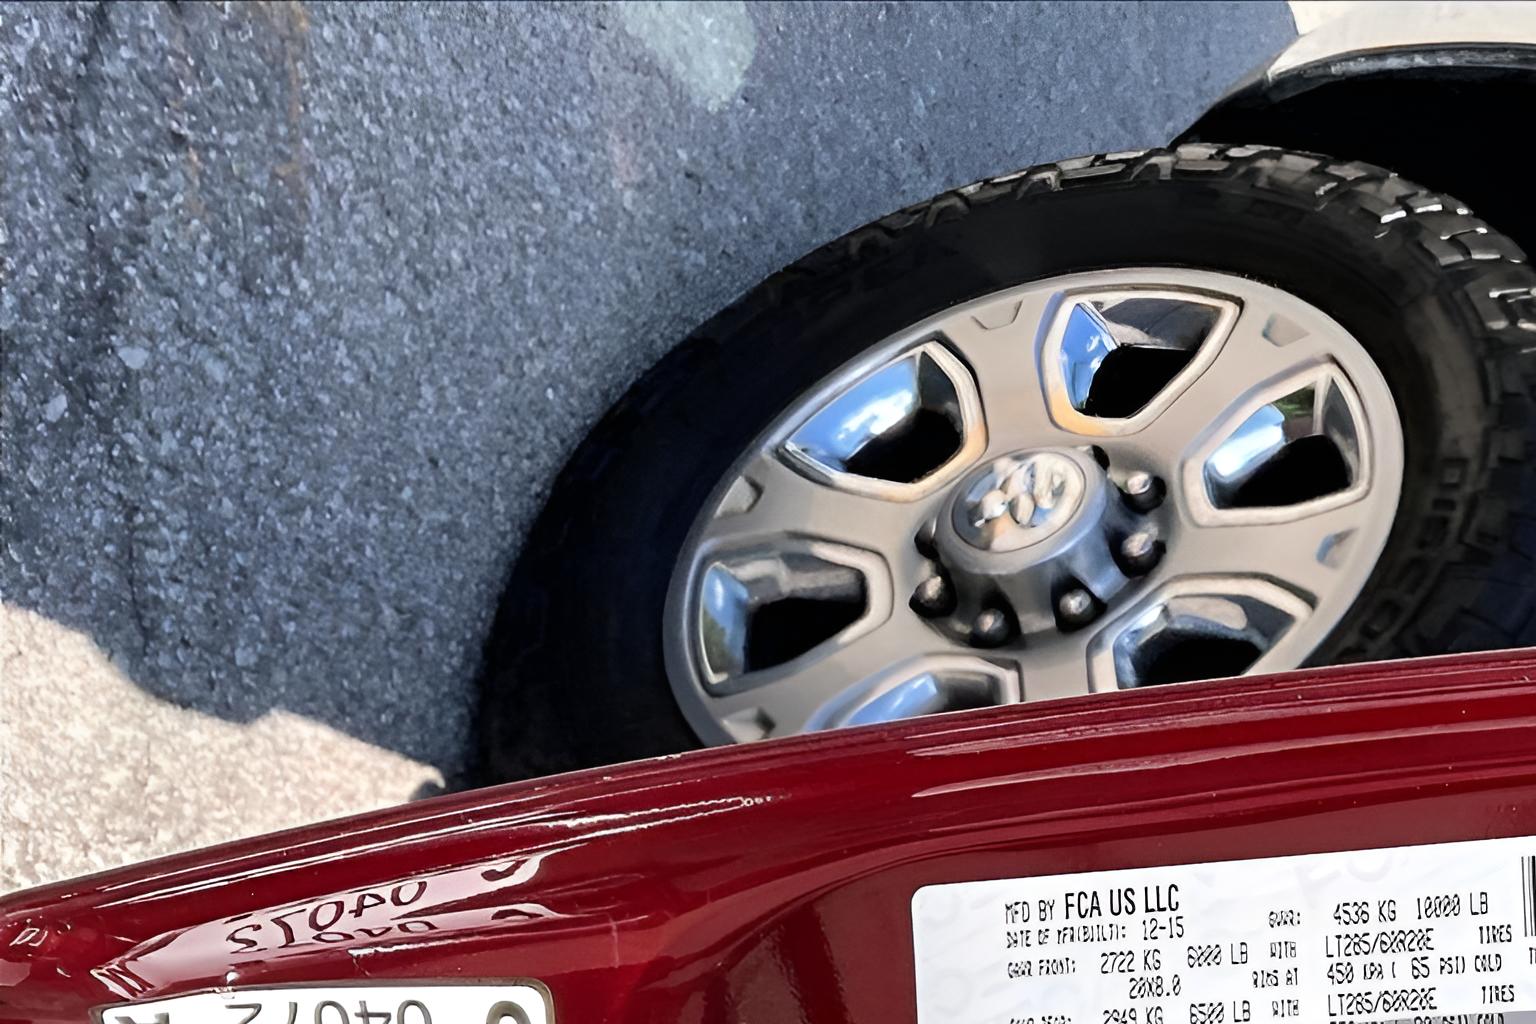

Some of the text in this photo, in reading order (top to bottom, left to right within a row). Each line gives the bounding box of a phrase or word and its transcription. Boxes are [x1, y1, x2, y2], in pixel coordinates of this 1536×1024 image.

[1005, 883, 1180, 924] MFD BY FCA US LLC
[1333, 901, 1370, 926] 4536
[1377, 899, 1397, 923] KG
[1416, 893, 1461, 920] 10000
[1469, 891, 1489, 916] LB
[1142, 915, 1185, 941] 12-15
[1100, 950, 1136, 975] 2722
[1143, 948, 1161, 971] KG
[1230, 941, 1248, 965] LB
[1478, 924, 1512, 945] TIRES
[1326, 961, 1355, 985] 450
[1411, 956, 1430, 980] 65
[1439, 955, 1466, 975] PSI)
[1474, 953, 1502, 973] COLD
[1233, 999, 1251, 1023] LB
[1481, 984, 1515, 1005] TIRES
